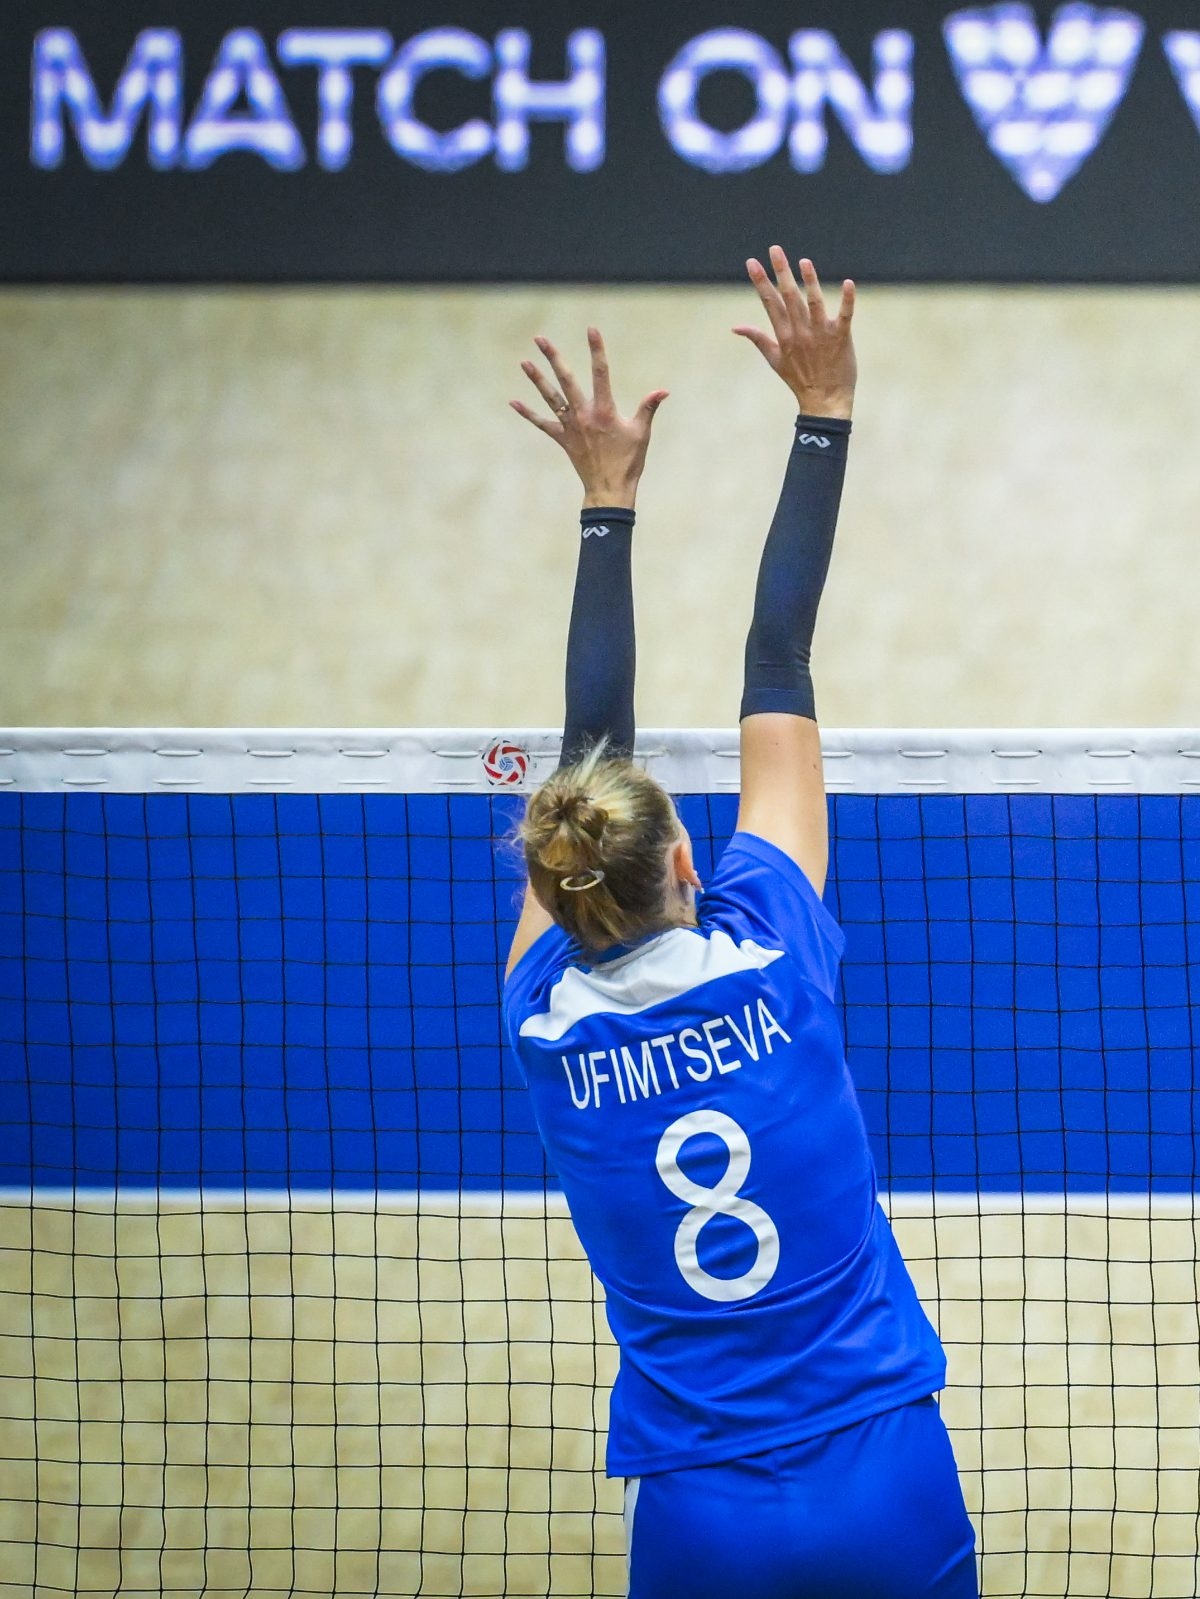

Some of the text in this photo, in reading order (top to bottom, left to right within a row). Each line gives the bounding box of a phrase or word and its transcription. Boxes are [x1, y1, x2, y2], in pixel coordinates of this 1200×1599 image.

[30, 26, 606, 172] MATCH
[656, 26, 915, 173] ON
[561, 997, 792, 1111] UFIMTSEVA
[655, 1109, 780, 1303] 8
